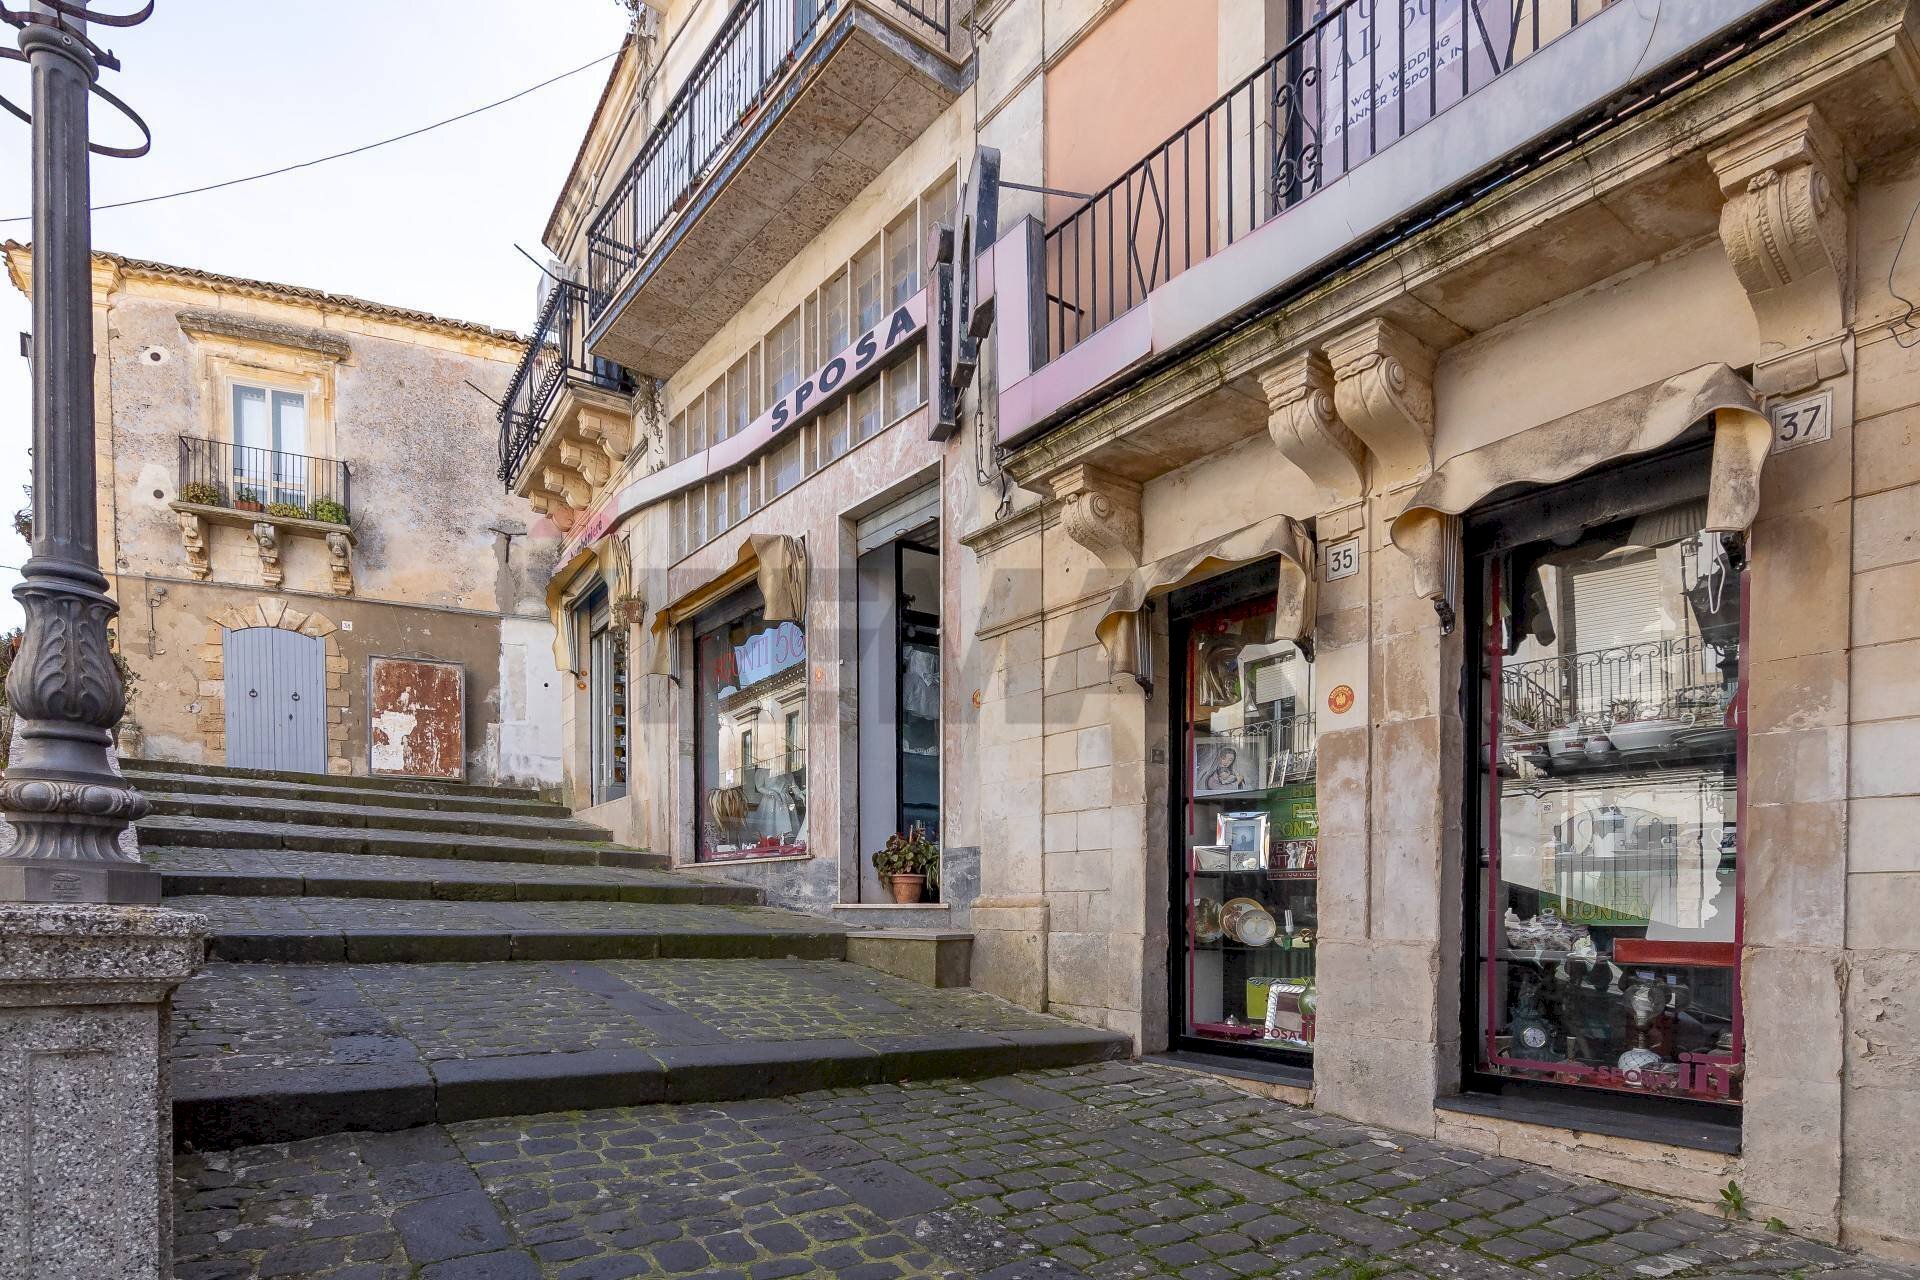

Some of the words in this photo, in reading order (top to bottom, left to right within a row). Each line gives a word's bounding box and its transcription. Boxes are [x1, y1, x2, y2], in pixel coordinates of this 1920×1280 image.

[1335, 94, 1387, 136] PANNER
[1404, 57, 1445, 90] SPOA
[771, 306, 916, 433] SPOSA
[1780, 404, 1822, 442] 37
[1332, 548, 1353, 573] 35
